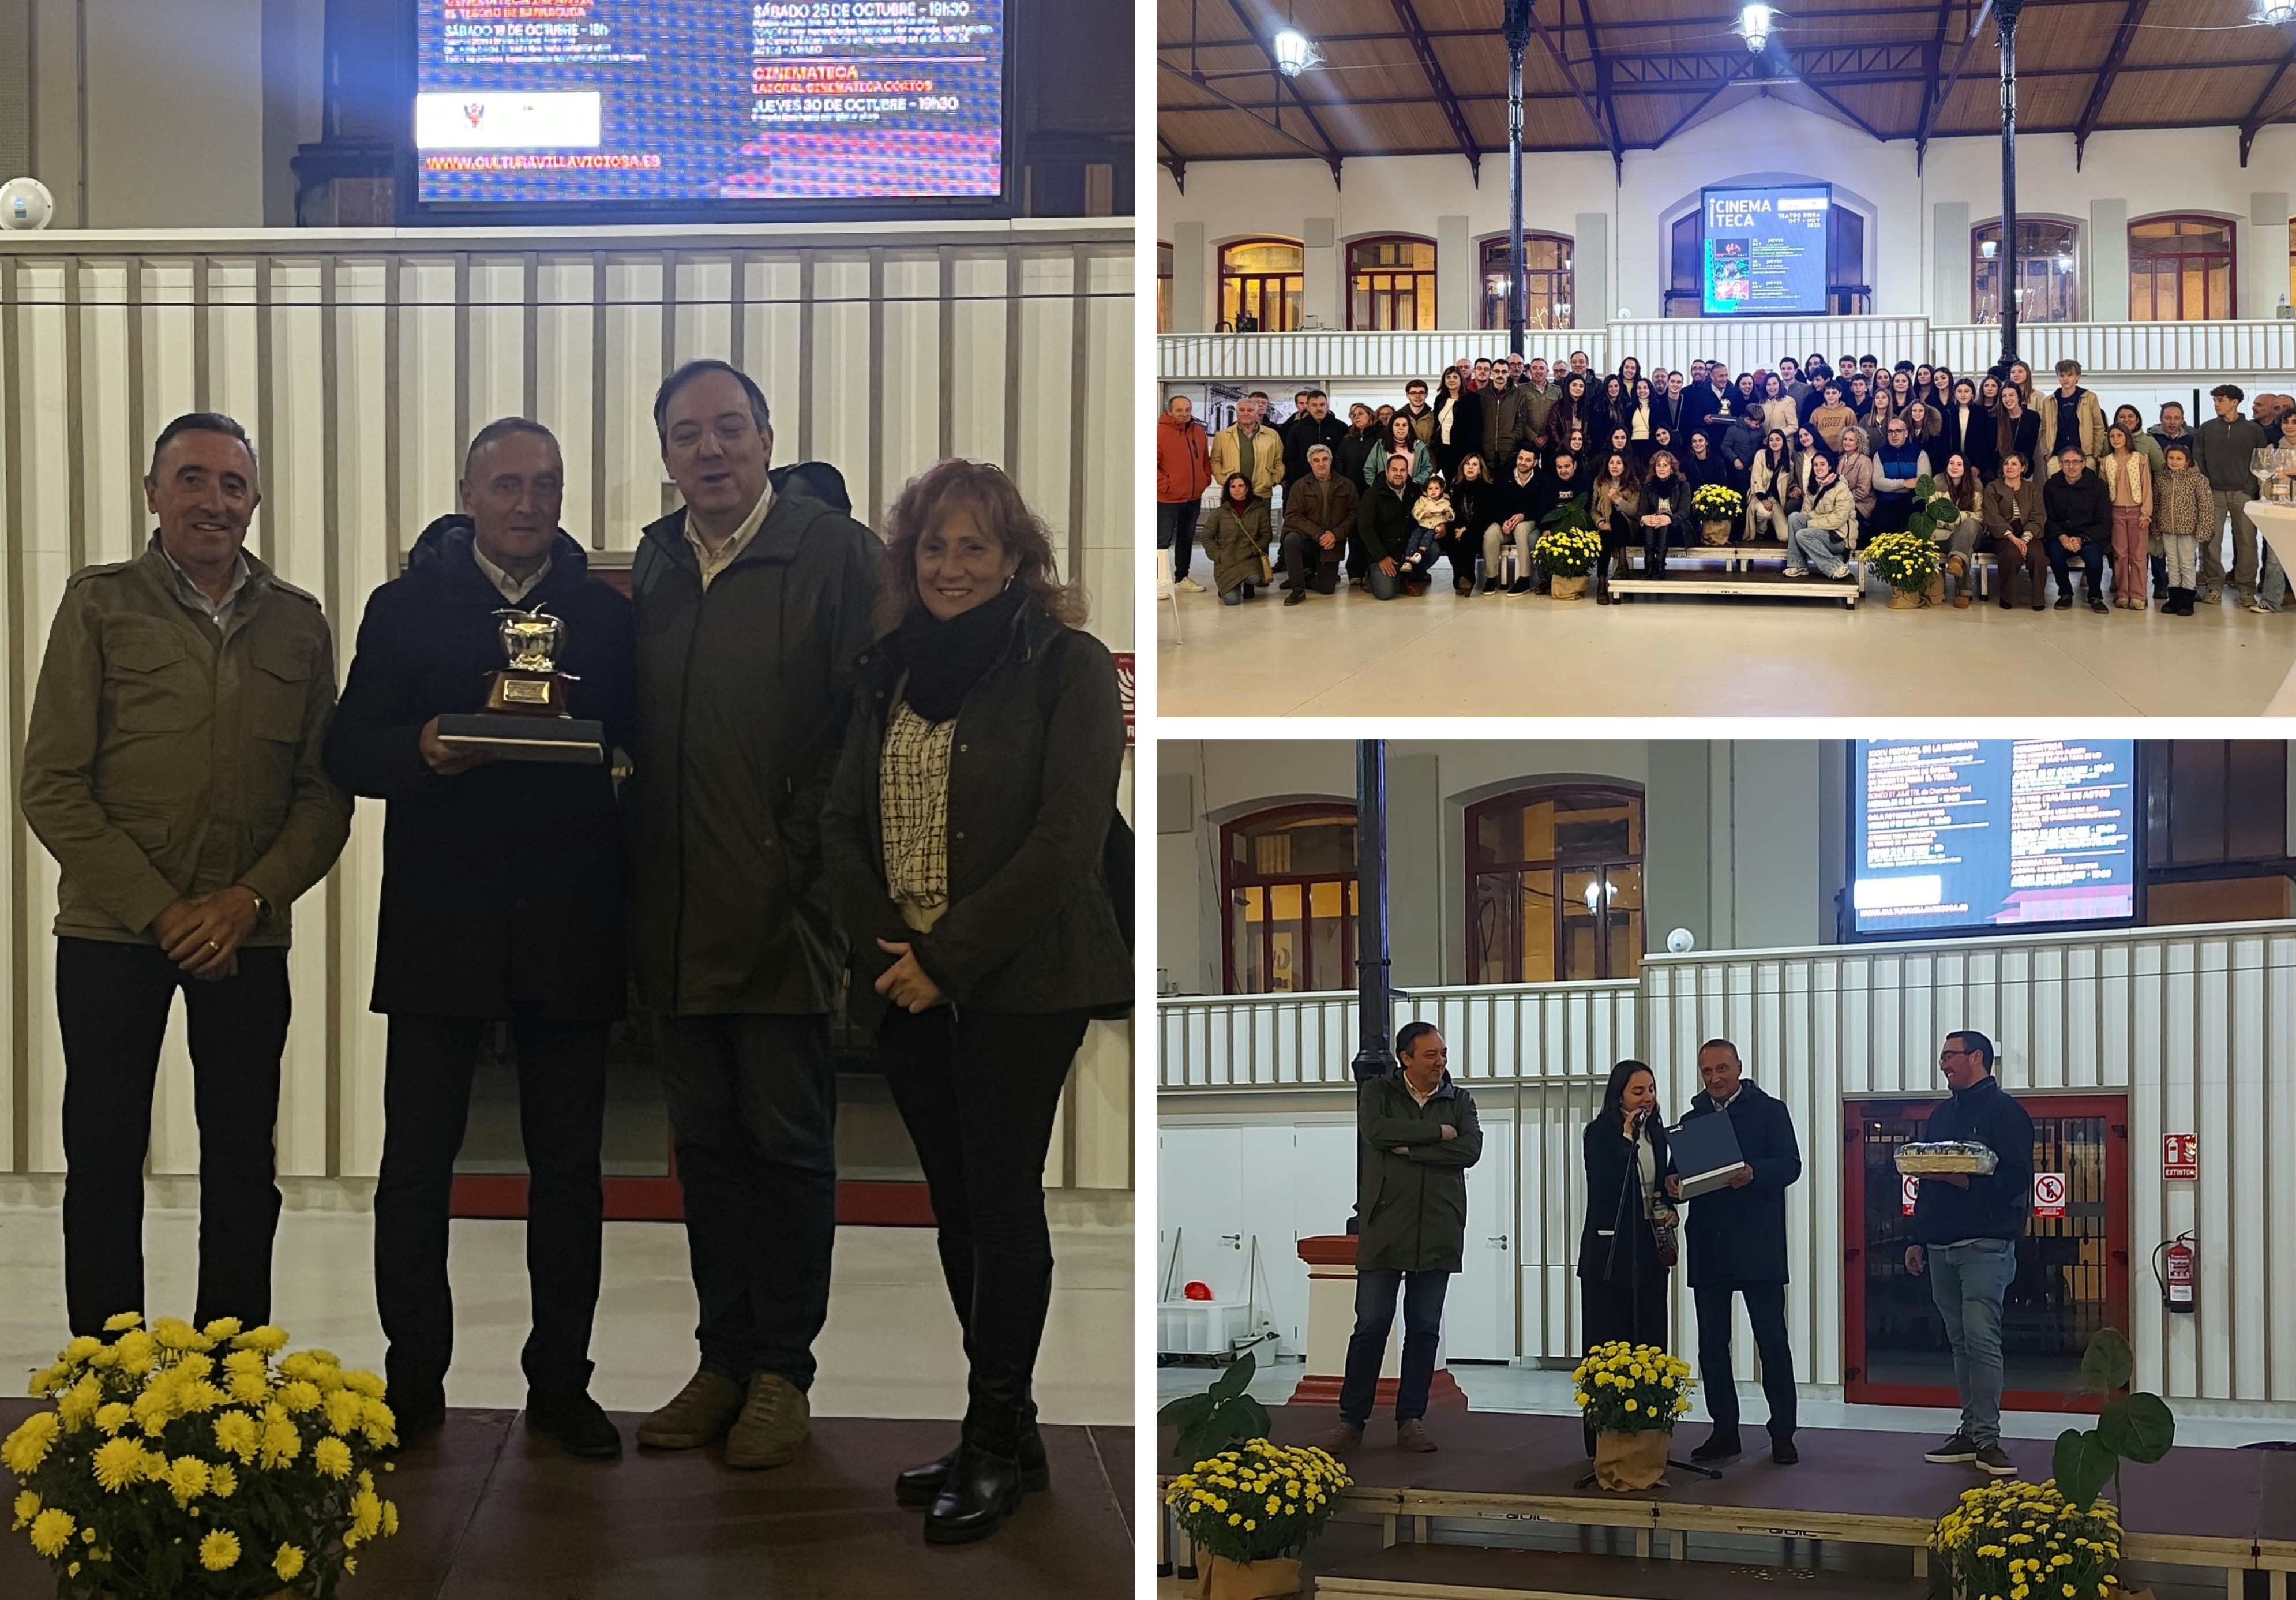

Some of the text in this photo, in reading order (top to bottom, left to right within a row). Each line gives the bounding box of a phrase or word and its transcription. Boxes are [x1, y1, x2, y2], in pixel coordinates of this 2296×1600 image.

[753, 2, 810, 18] SÁBADO
[812, 3, 830, 17] 25
[831, 3, 851, 16] DE
[852, 2, 916, 16] OCTUBRE
[507, 24, 523, 36] DE
[524, 23, 580, 36] OCTUBRE
[752, 66, 858, 80] CINEMATECA
[752, 99, 802, 113] JUEVES
[804, 99, 822, 111] 30
[824, 99, 843, 111] DE
[844, 98, 906, 110] OCTUBRE
[1716, 199, 1772, 213] CINEMA
[1716, 214, 1754, 227] TECA
[1506, 1513, 1550, 1522] GUIL
